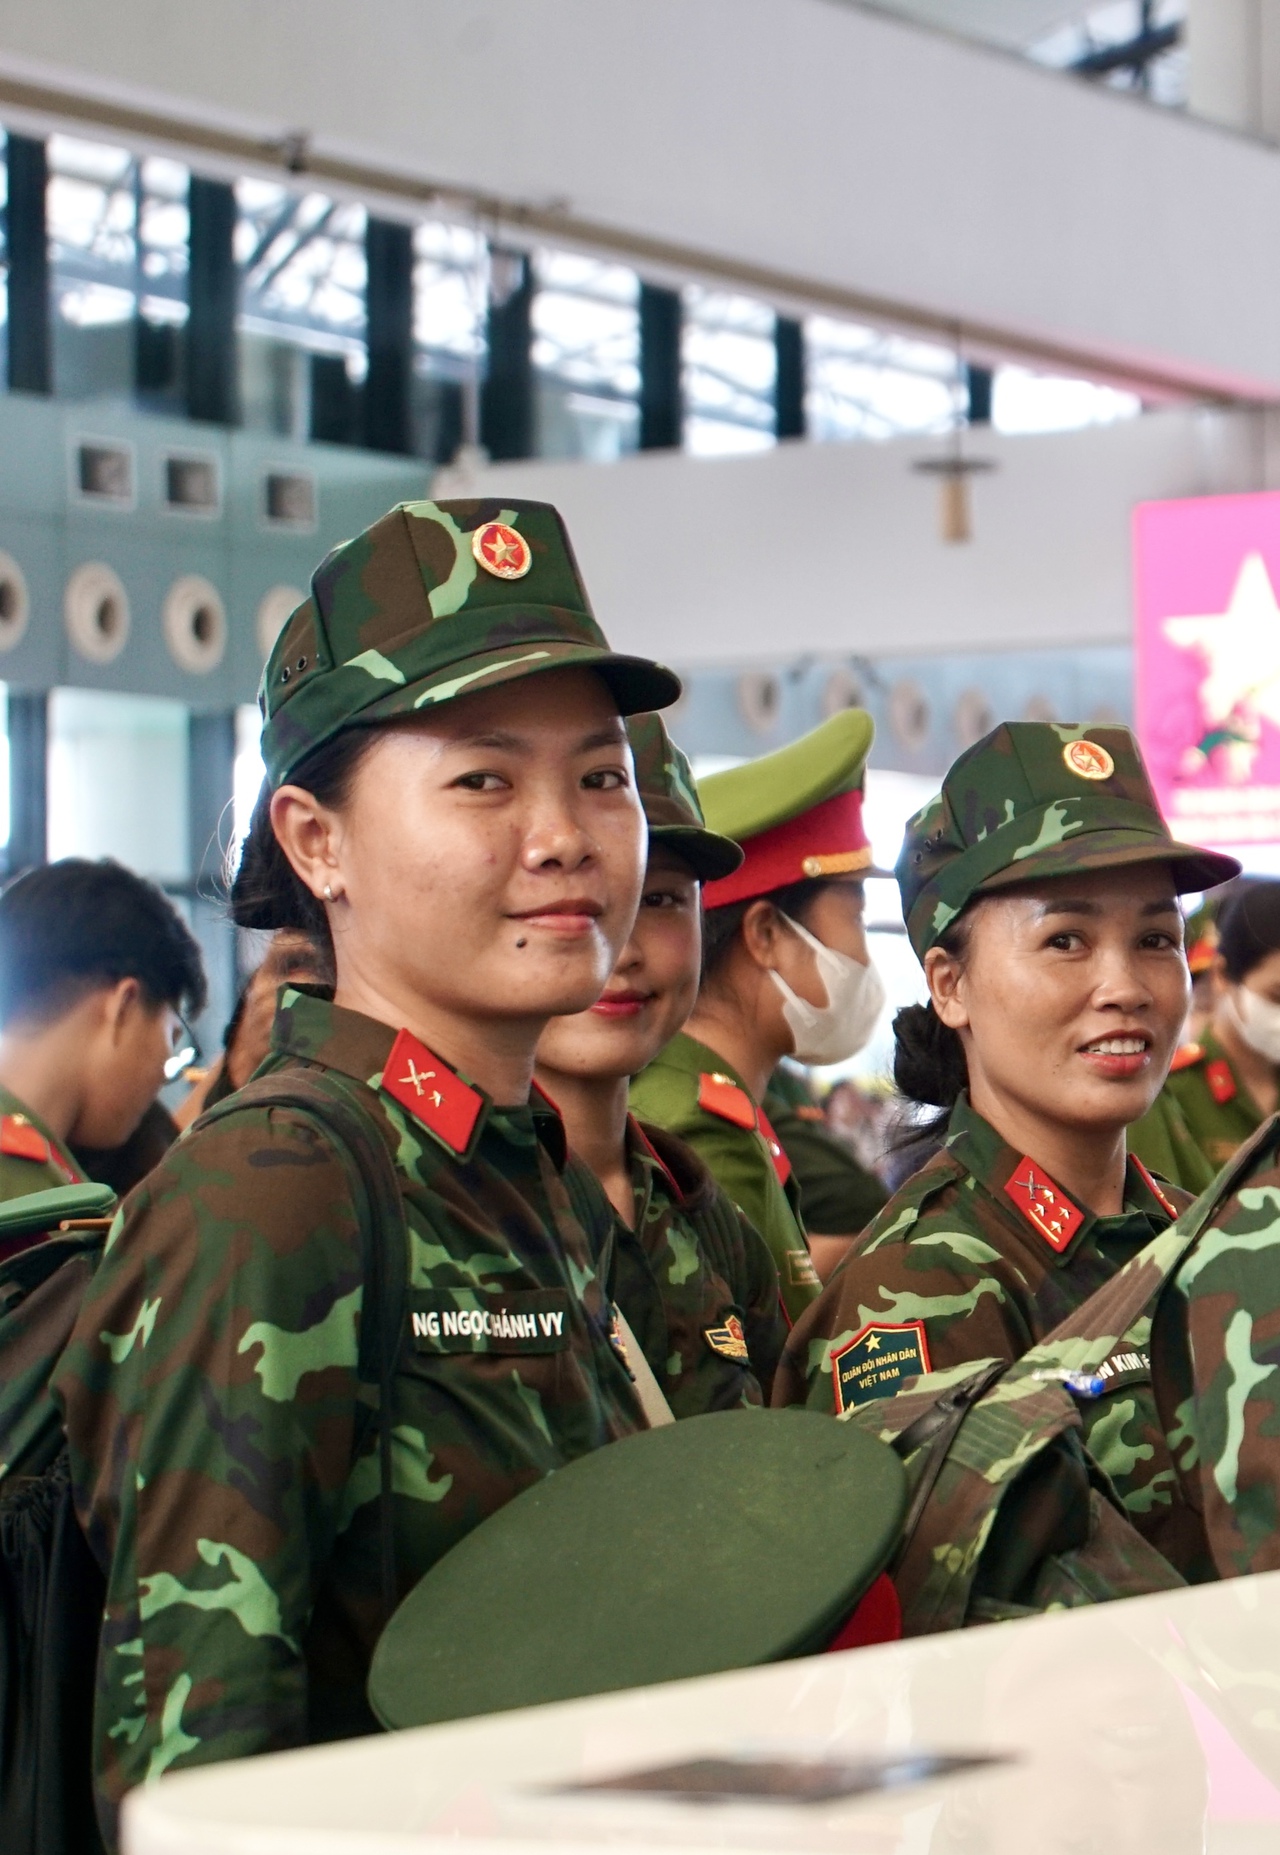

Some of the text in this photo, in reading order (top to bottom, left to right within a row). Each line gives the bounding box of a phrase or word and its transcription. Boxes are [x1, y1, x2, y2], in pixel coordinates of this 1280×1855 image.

[442, 1310, 492, 1342] NGỌC
[490, 1308, 538, 1339] HÁNH
[537, 1311, 564, 1337] VY
[842, 1365, 862, 1383] QUÂN
[875, 1352, 898, 1367] NHÂN
[898, 1347, 917, 1361] DÂN
[1111, 1352, 1145, 1373] KIM
[858, 1367, 900, 1389] VIỆT NAM
